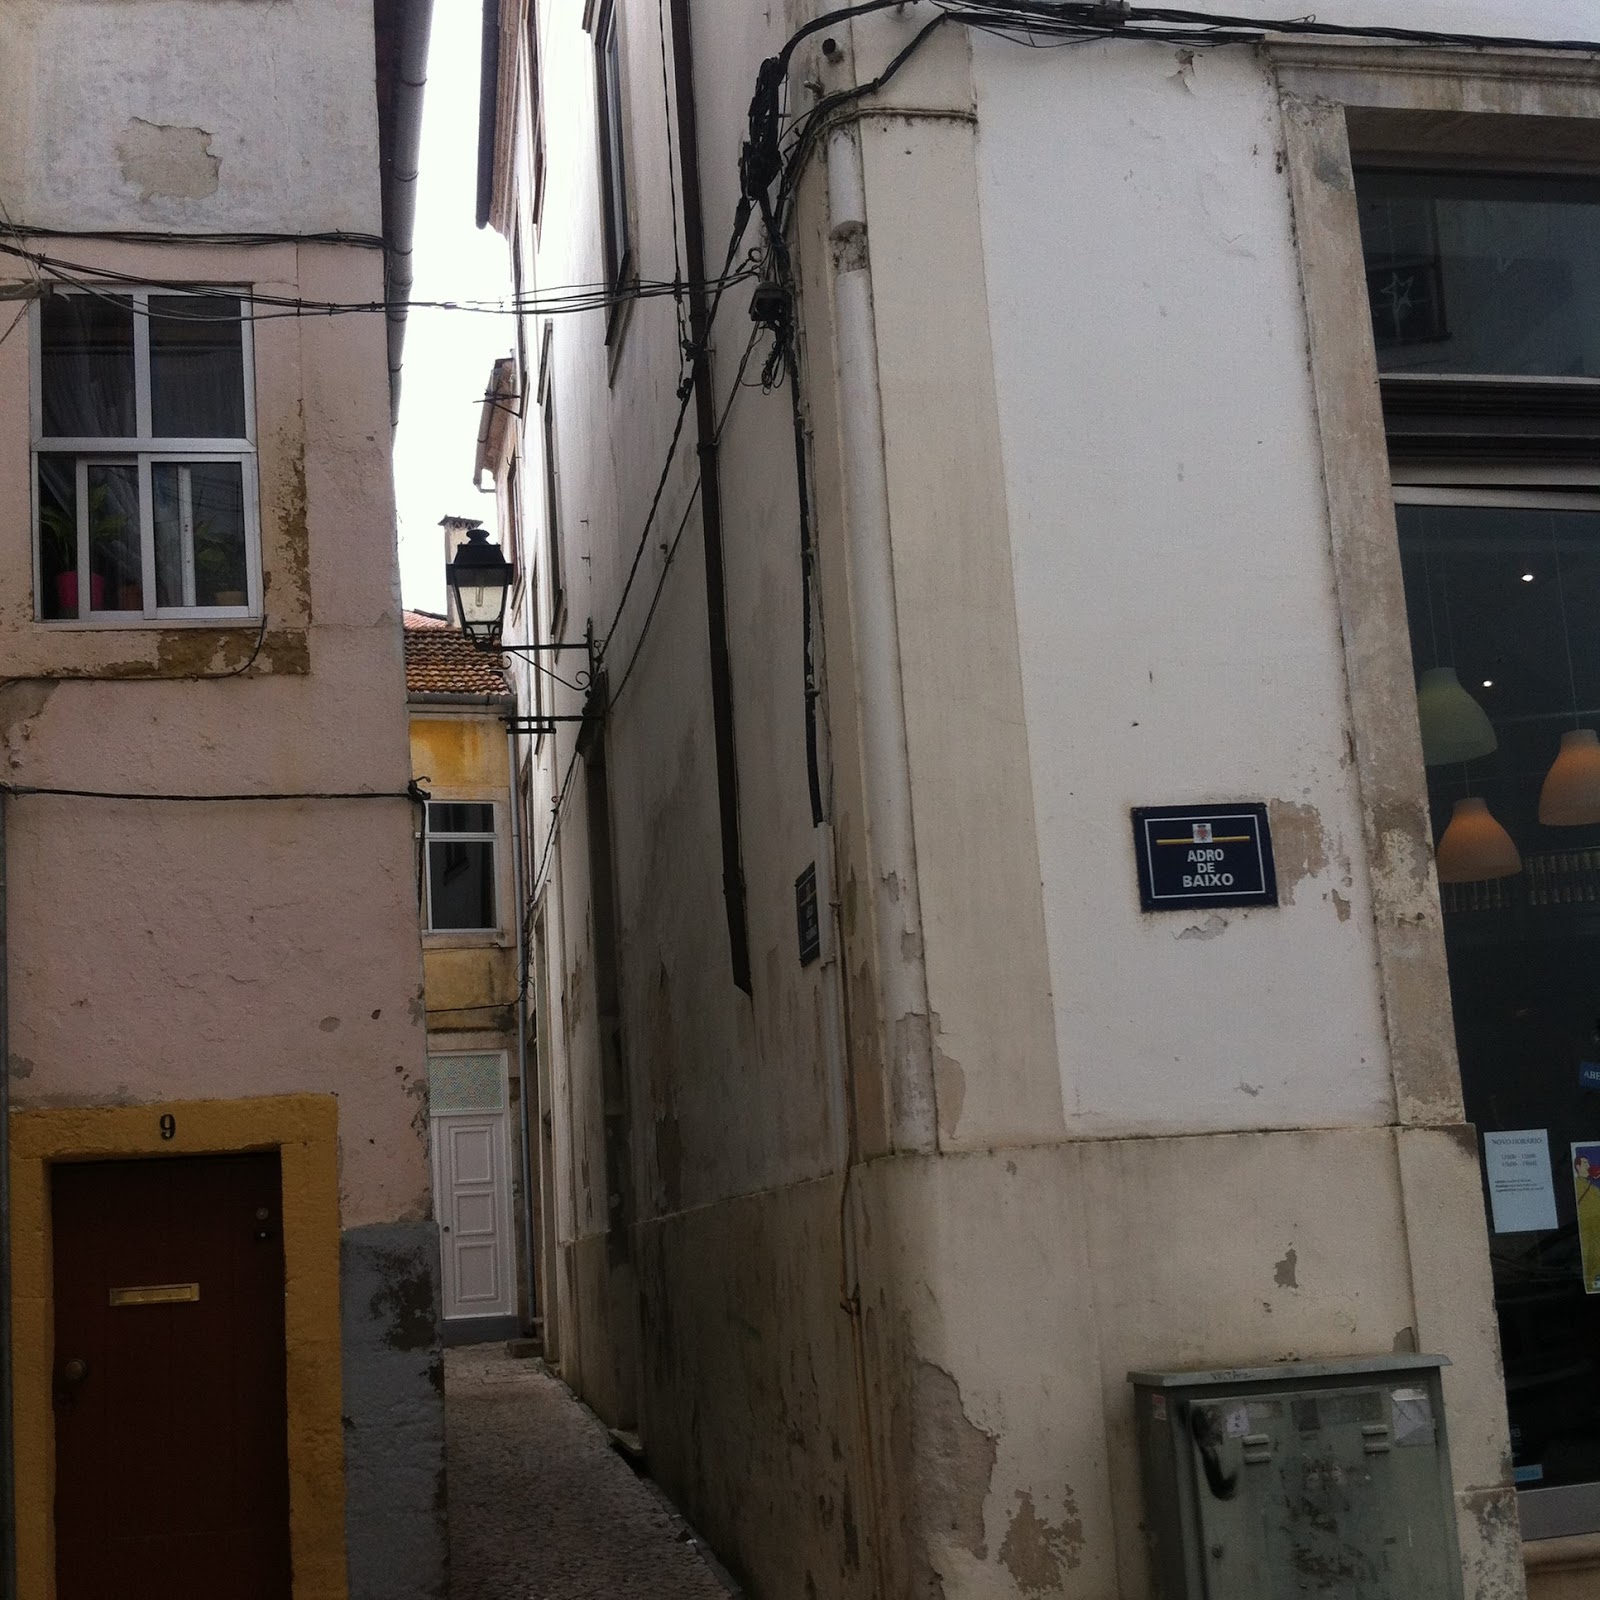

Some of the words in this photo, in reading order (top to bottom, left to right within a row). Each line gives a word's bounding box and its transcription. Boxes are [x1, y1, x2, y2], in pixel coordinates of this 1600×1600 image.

[1187, 848, 1224, 862] ADRO
[1197, 862, 1215, 873] DE
[1182, 873, 1234, 887] BAIXO
[160, 1114, 175, 1141] 9
